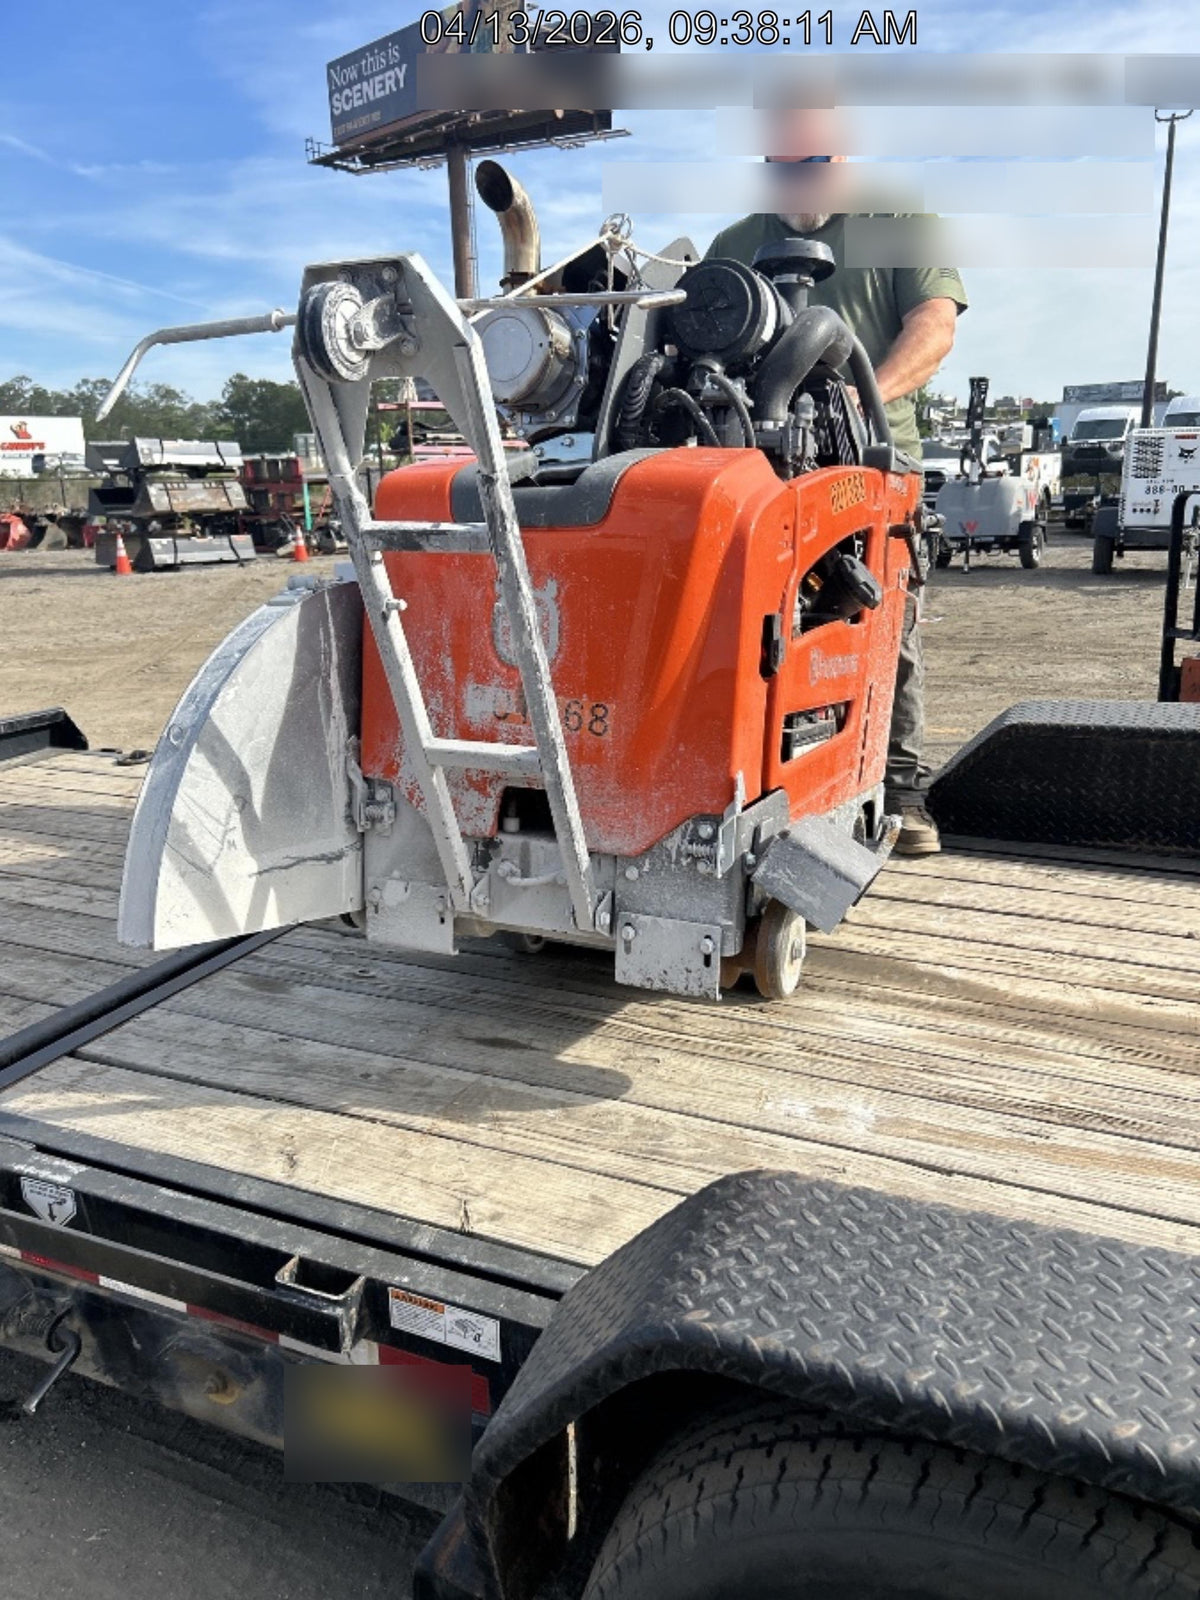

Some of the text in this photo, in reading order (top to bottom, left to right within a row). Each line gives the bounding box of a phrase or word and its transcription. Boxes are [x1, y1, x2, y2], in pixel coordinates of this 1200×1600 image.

[329, 41, 400, 90] Now this is
[331, 63, 407, 116] SCENERY
